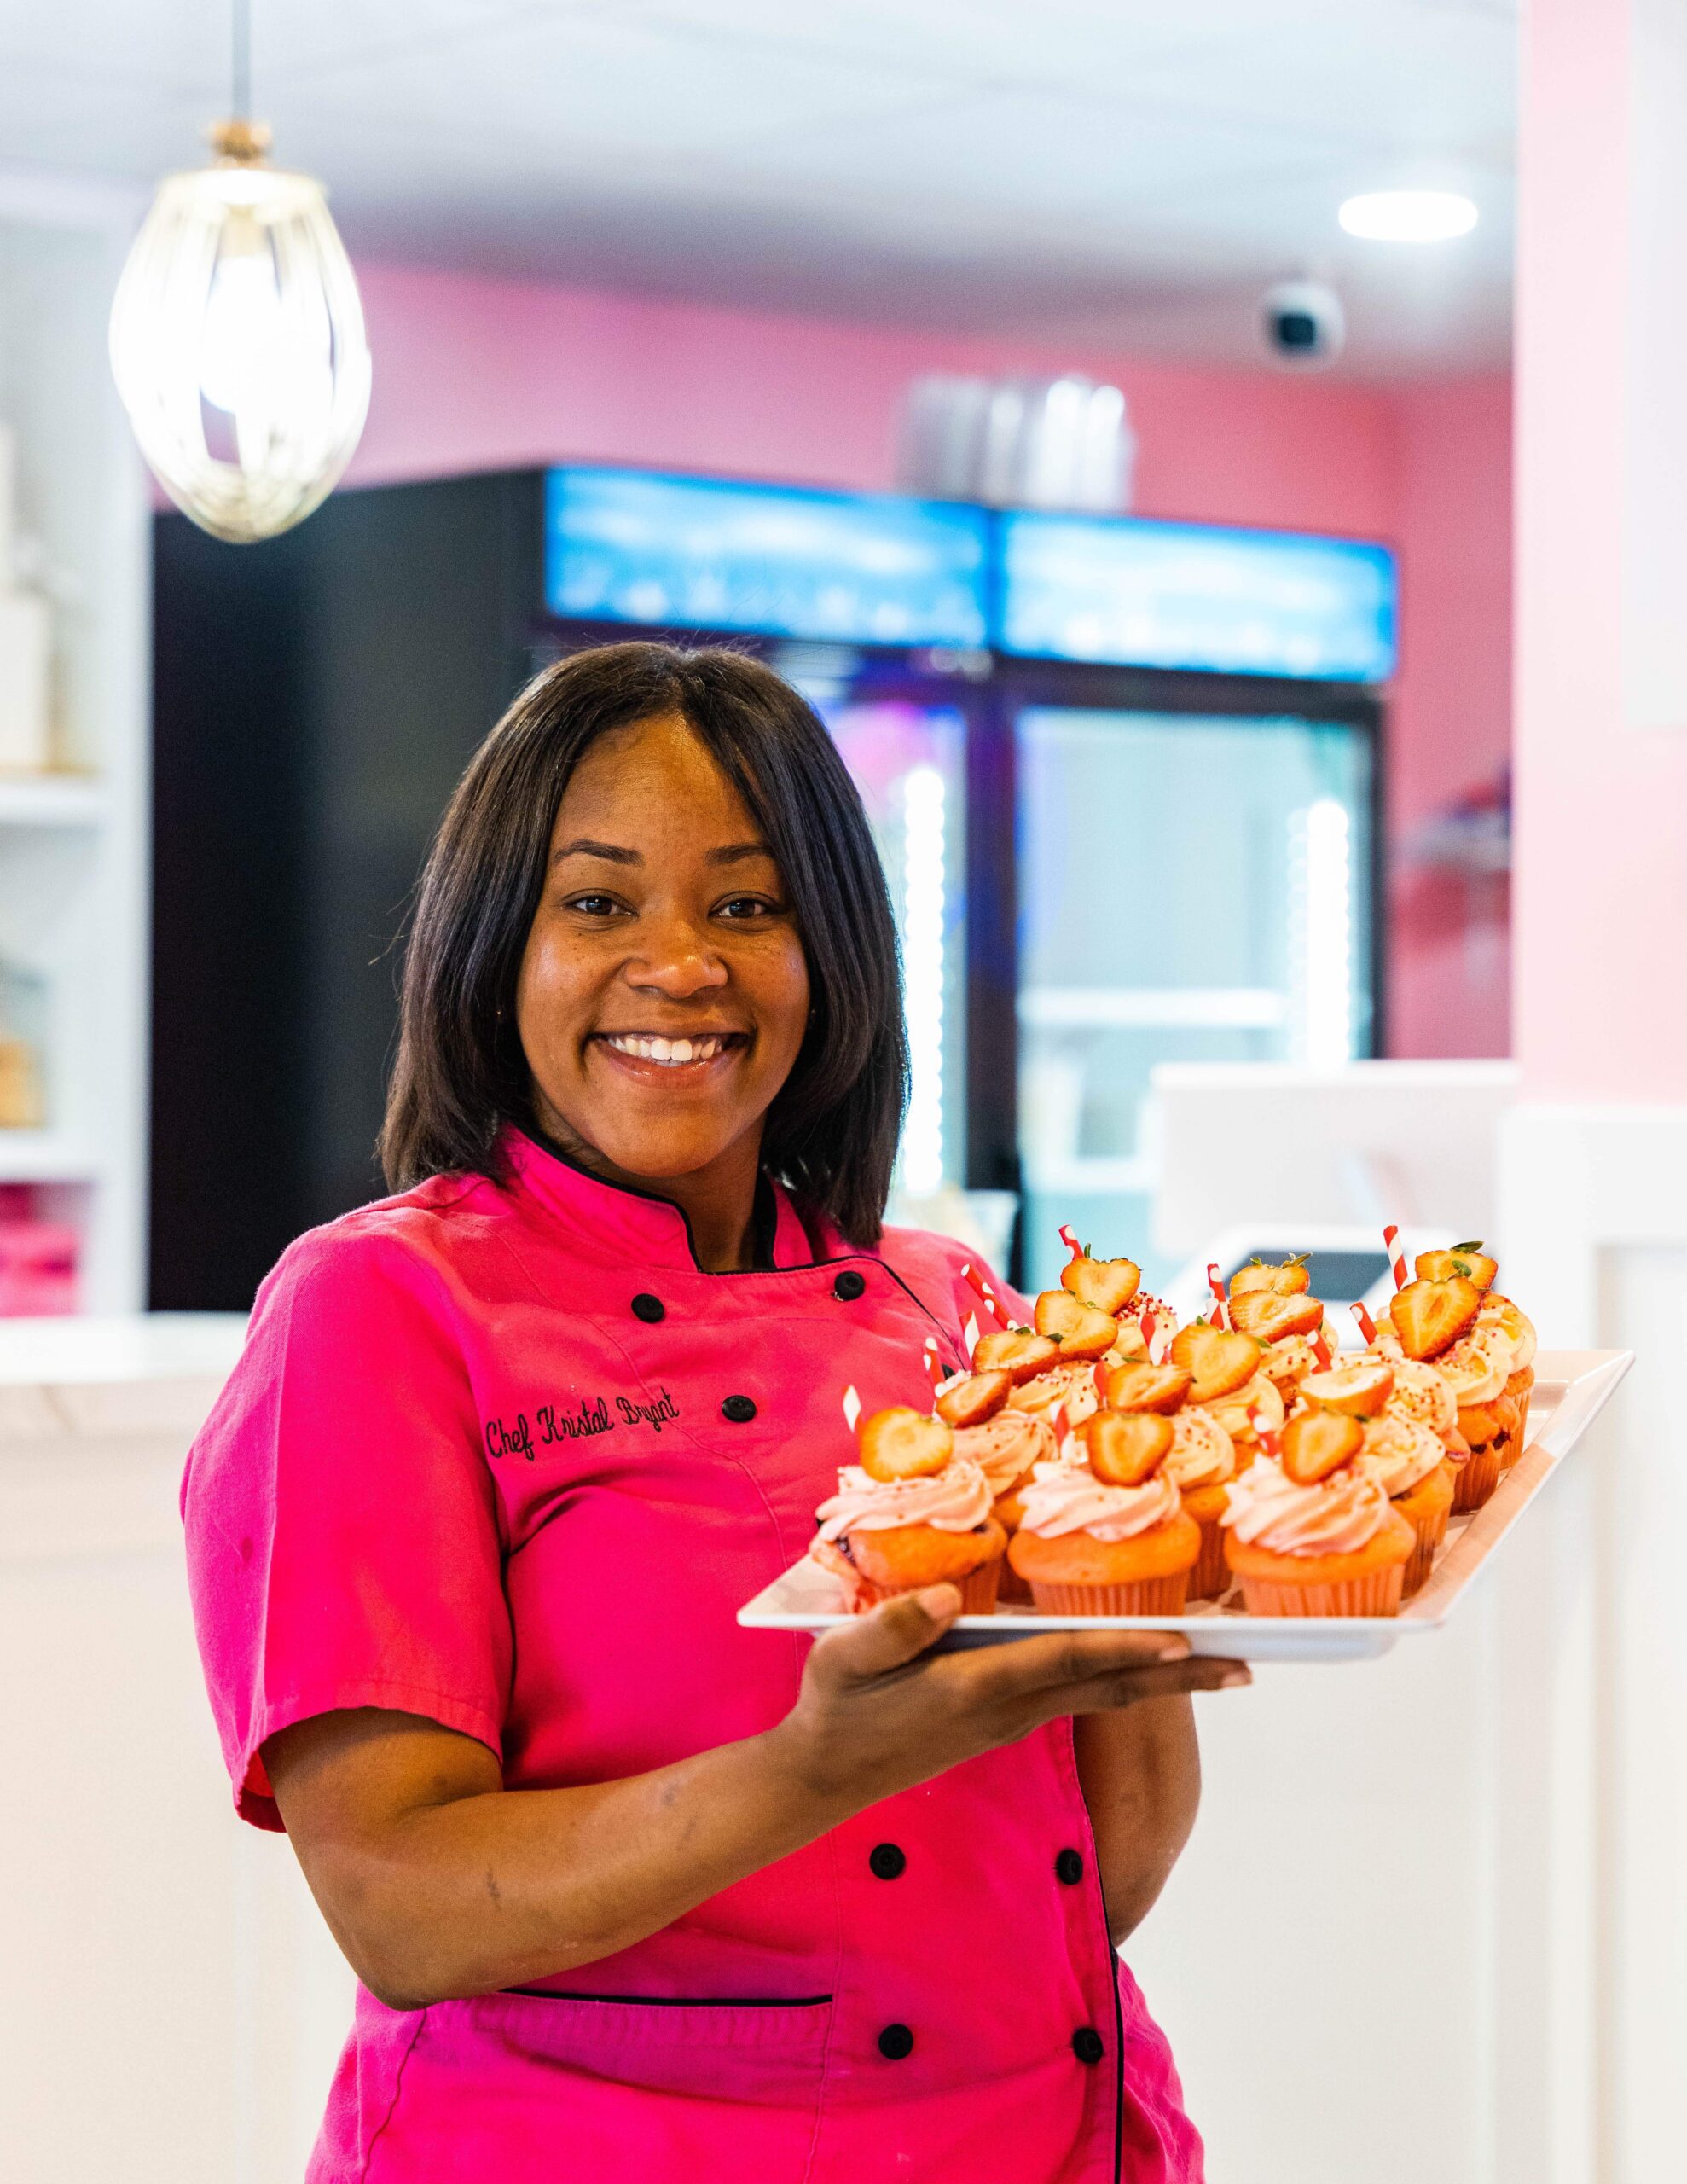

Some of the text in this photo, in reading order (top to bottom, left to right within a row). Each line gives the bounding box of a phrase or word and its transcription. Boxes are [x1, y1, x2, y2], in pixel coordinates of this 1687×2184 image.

[486, 1385, 680, 1461] Chef Kristal Bryant
